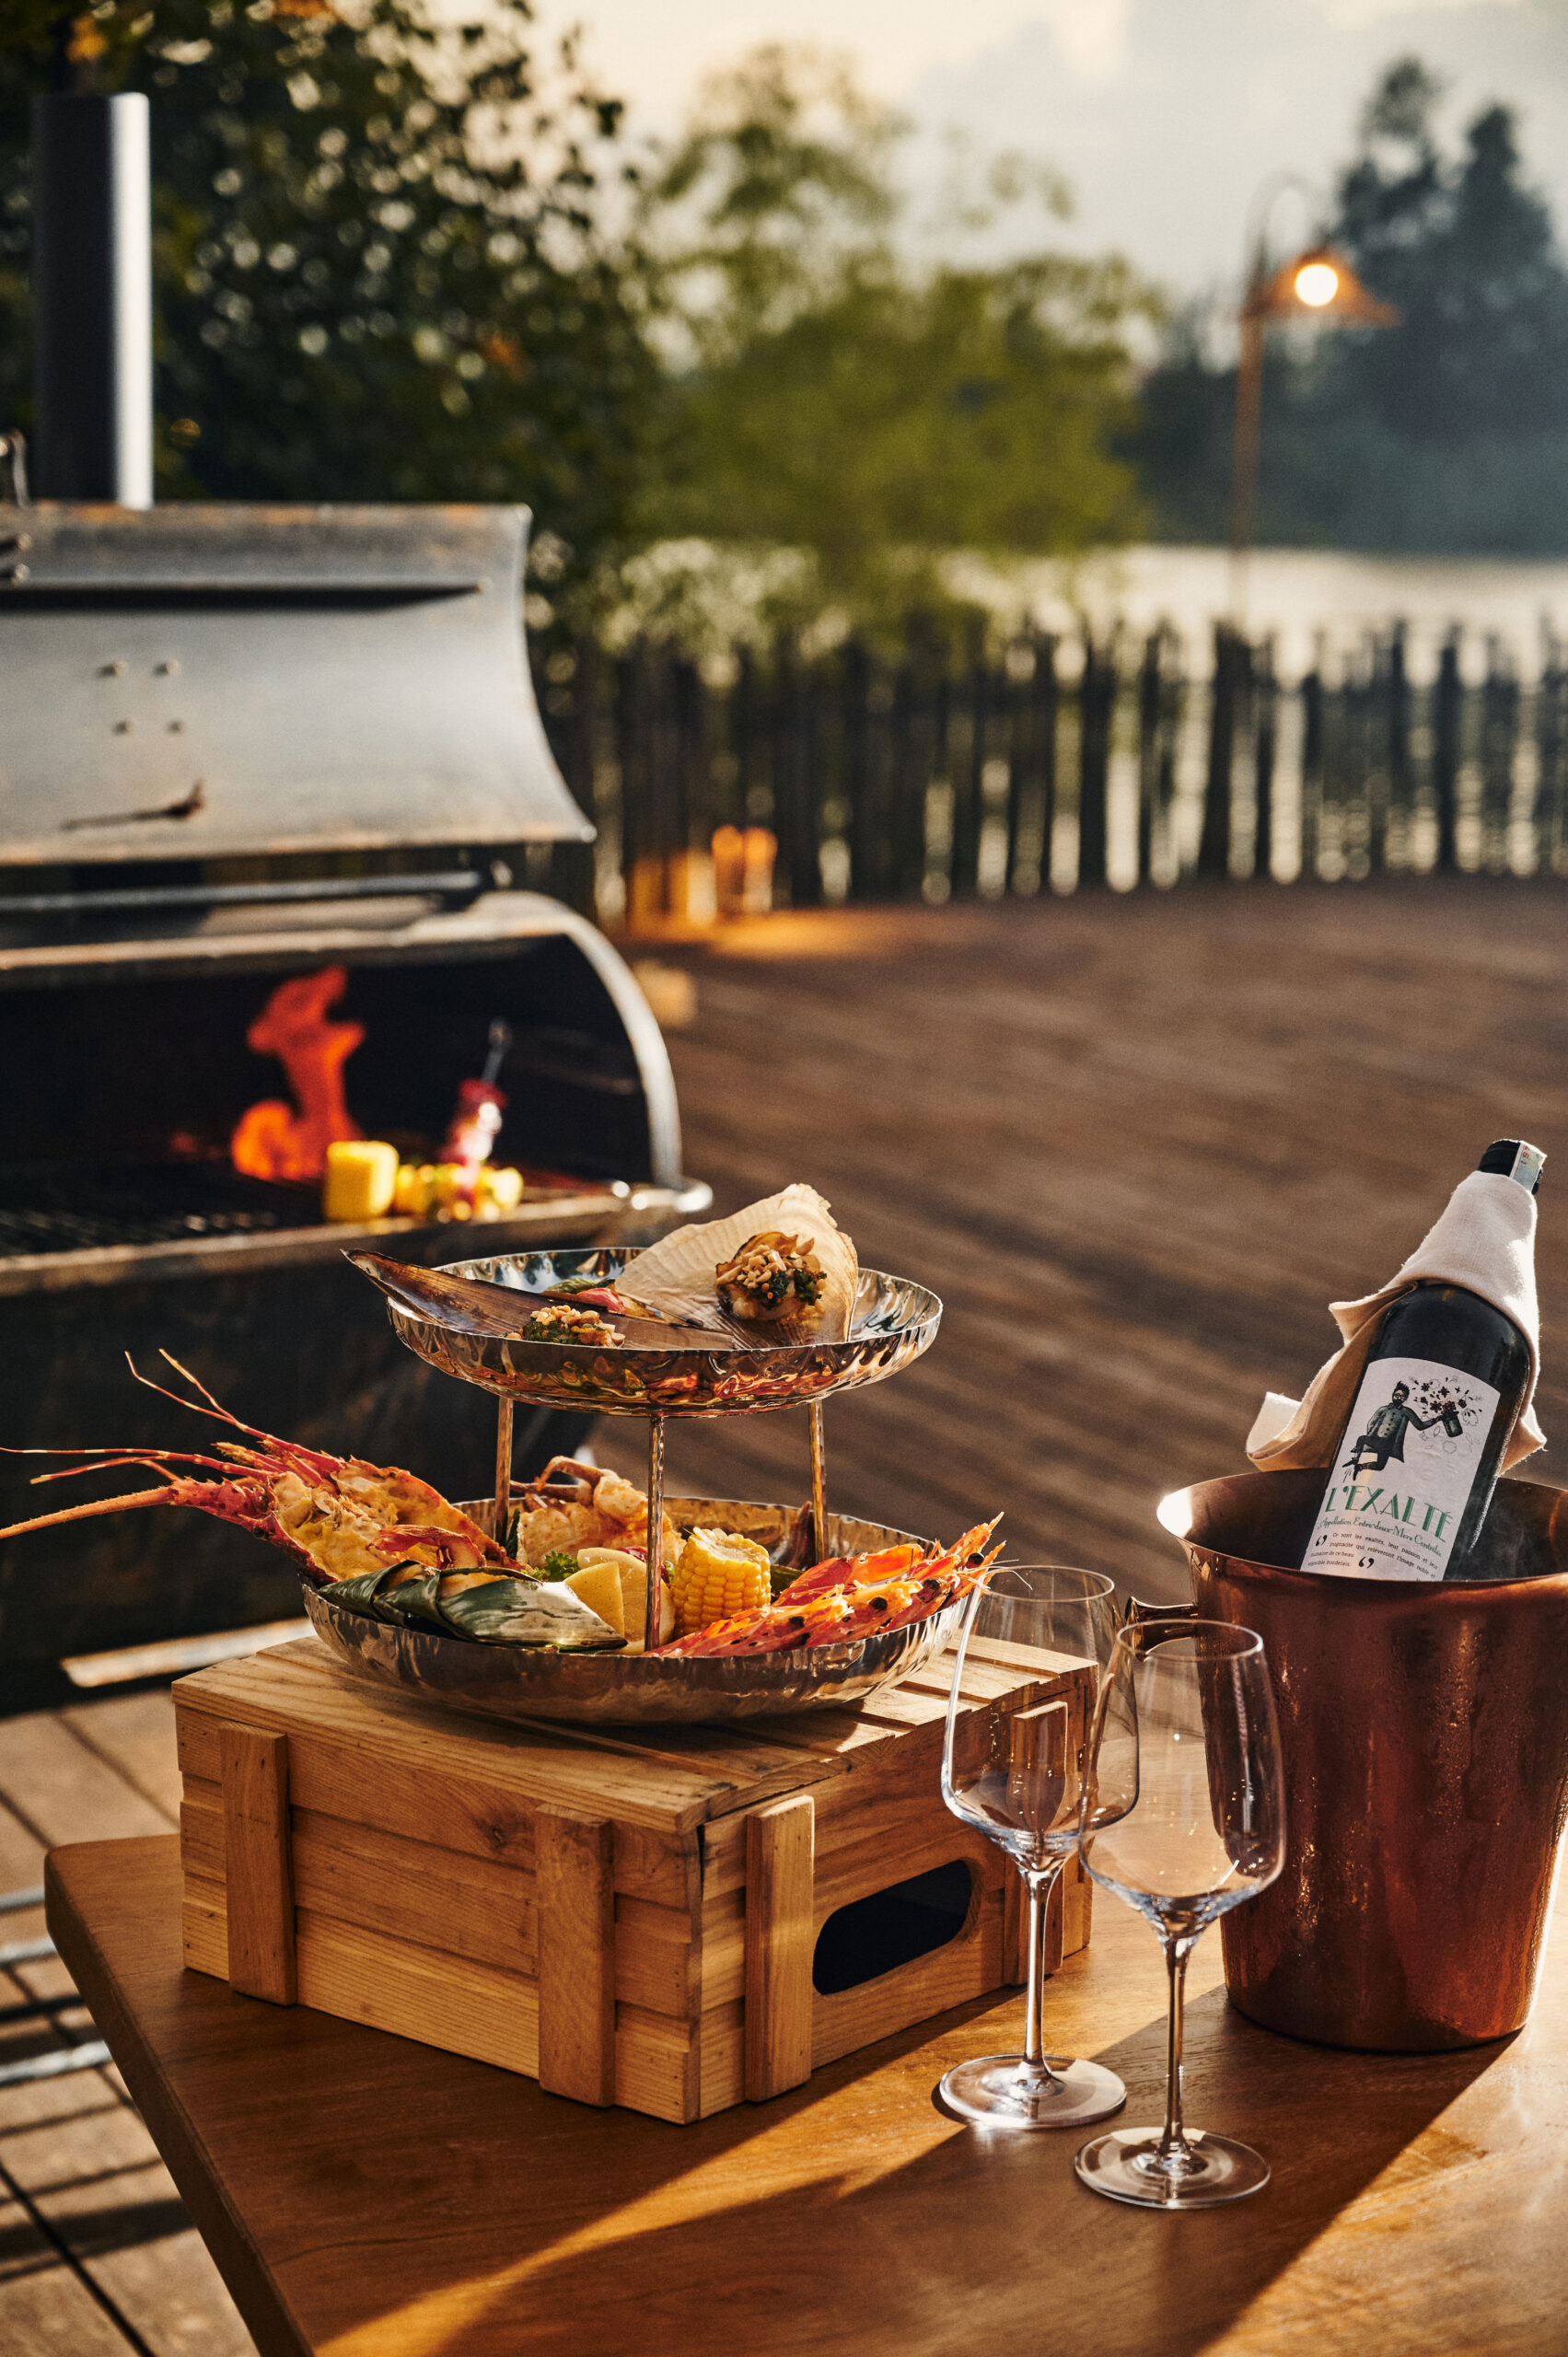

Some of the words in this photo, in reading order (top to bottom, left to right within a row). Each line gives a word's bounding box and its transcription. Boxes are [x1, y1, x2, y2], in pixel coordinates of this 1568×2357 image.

[1325, 1485, 1453, 1543] L'EXALTÉ
[1318, 1516, 1352, 1529] Appellation
[1353, 1516, 1412, 1541] Entre-deux-Mers
[1388, 1541, 1400, 1550] leur
[1401, 1548, 1421, 1560] passion
[1416, 1565, 1430, 1575] noble
